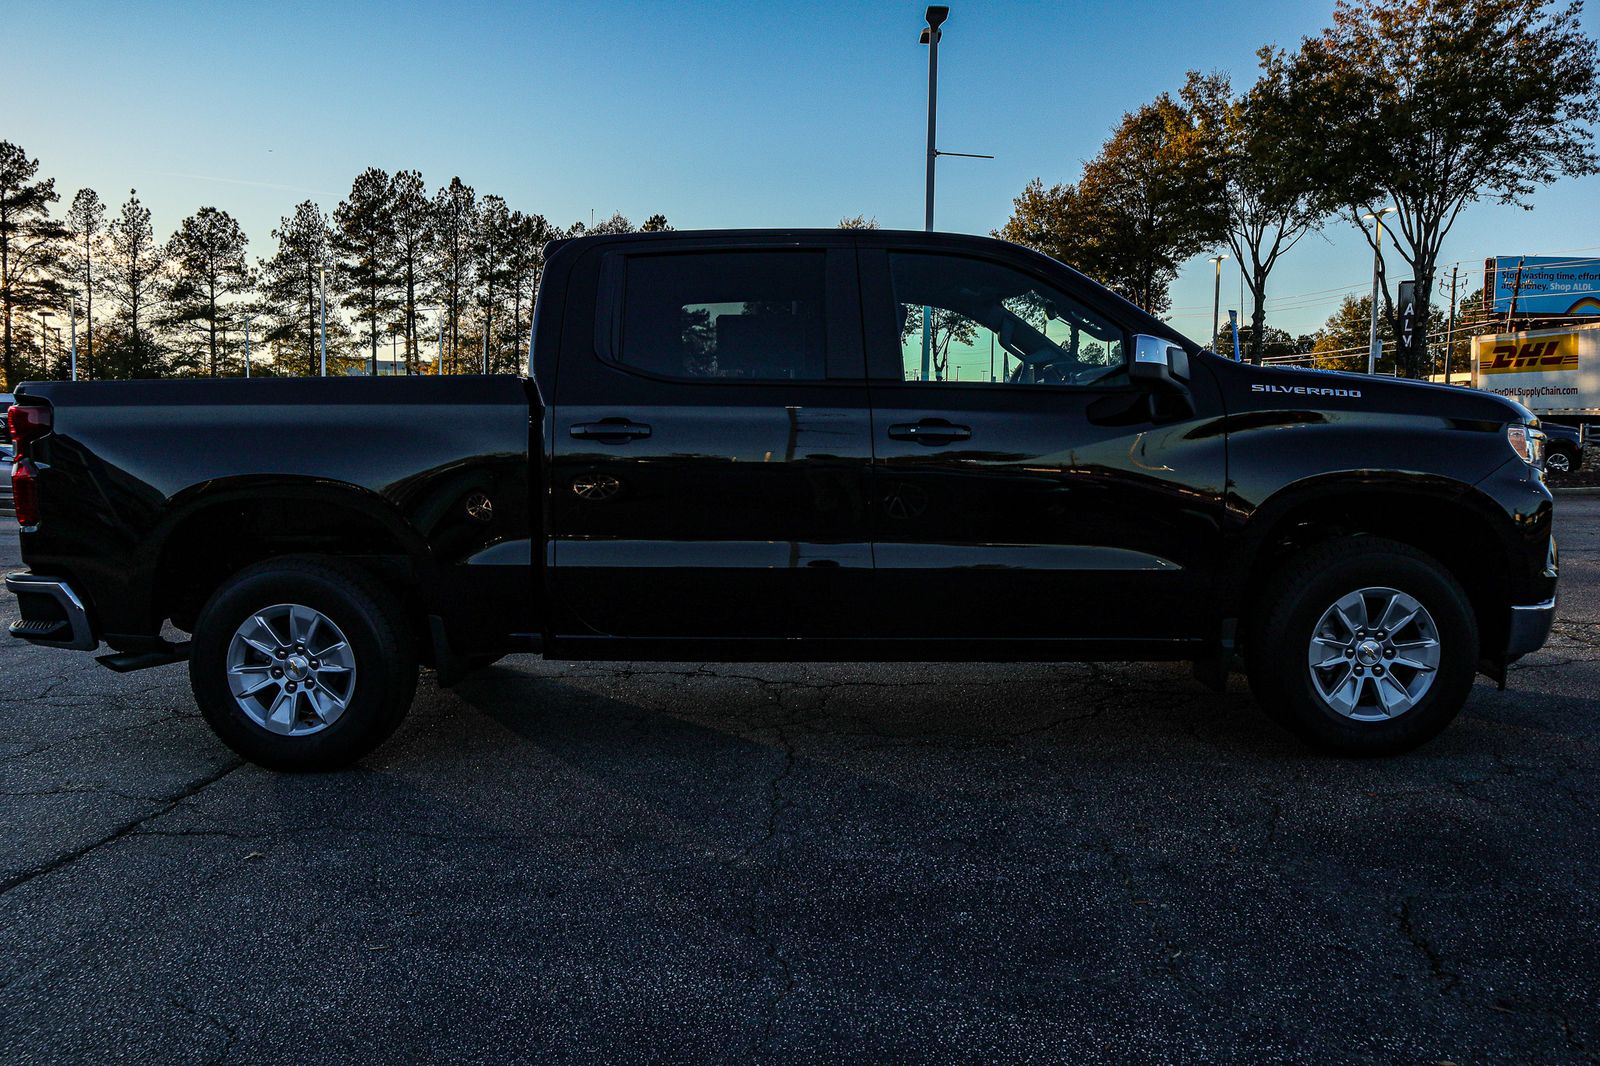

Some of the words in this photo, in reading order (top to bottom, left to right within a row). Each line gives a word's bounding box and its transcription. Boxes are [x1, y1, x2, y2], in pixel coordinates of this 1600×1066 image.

[1522, 272, 1554, 281] wasting
[1556, 272, 1577, 281] time,
[1550, 282, 1571, 292] Shop
[1572, 283, 1593, 291] ALDI.
[1490, 341, 1564, 368] DHL
[1251, 384, 1362, 398] SILVERADO
